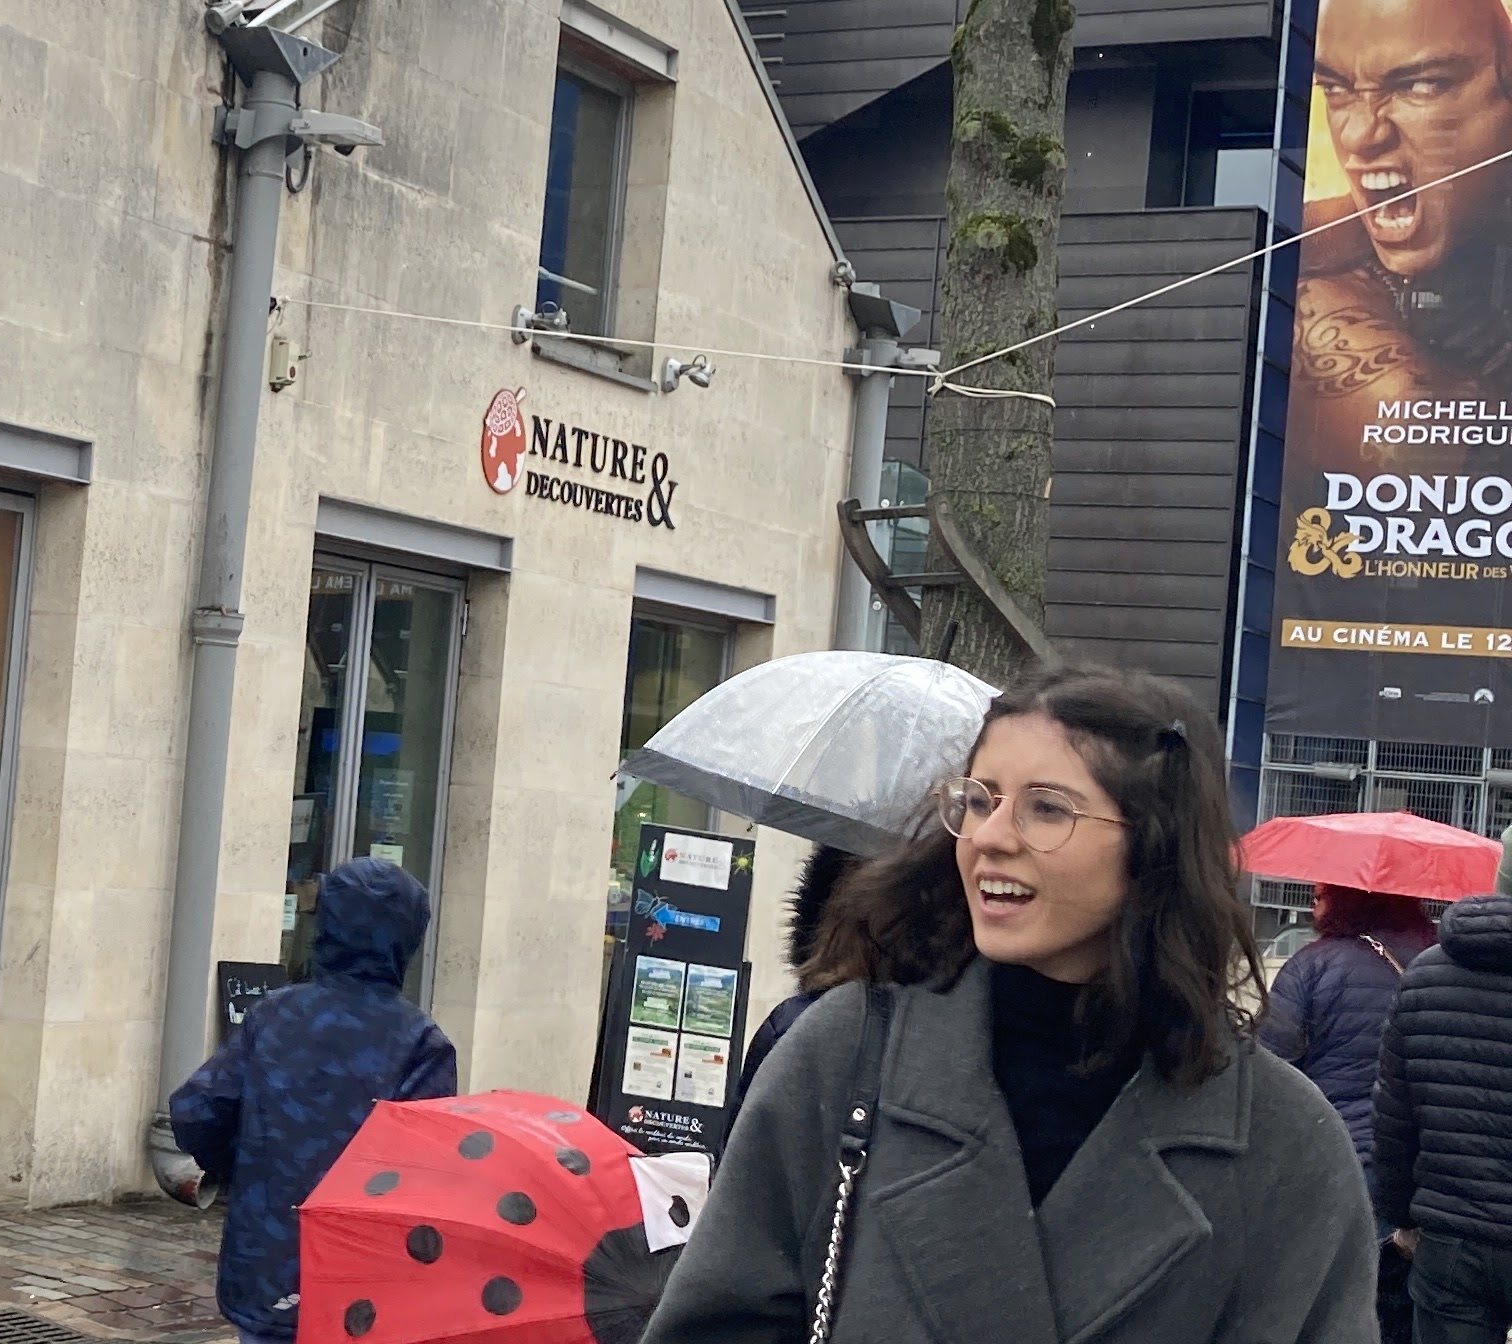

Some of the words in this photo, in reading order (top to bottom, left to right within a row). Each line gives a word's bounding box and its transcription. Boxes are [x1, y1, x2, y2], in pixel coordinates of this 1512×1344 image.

[1377, 400, 1512, 421] MICHELL
[1362, 425, 1512, 446] RODRIGU
[528, 414, 648, 485] NATURE
[646, 452, 679, 530] &
[525, 470, 644, 522] DECOUVERTES
[1323, 472, 1512, 515] DONJO
[1364, 559, 1478, 580] L'HONNEUR
[1483, 566, 1507, 579] DES
[1289, 625, 1322, 643] AU
[1333, 625, 1429, 647] CINÉMA
[1441, 631, 1474, 650] LE
[1486, 632, 1512, 652] 12
[645, 1109, 690, 1125] NATURE
[689, 1117, 704, 1134] &
